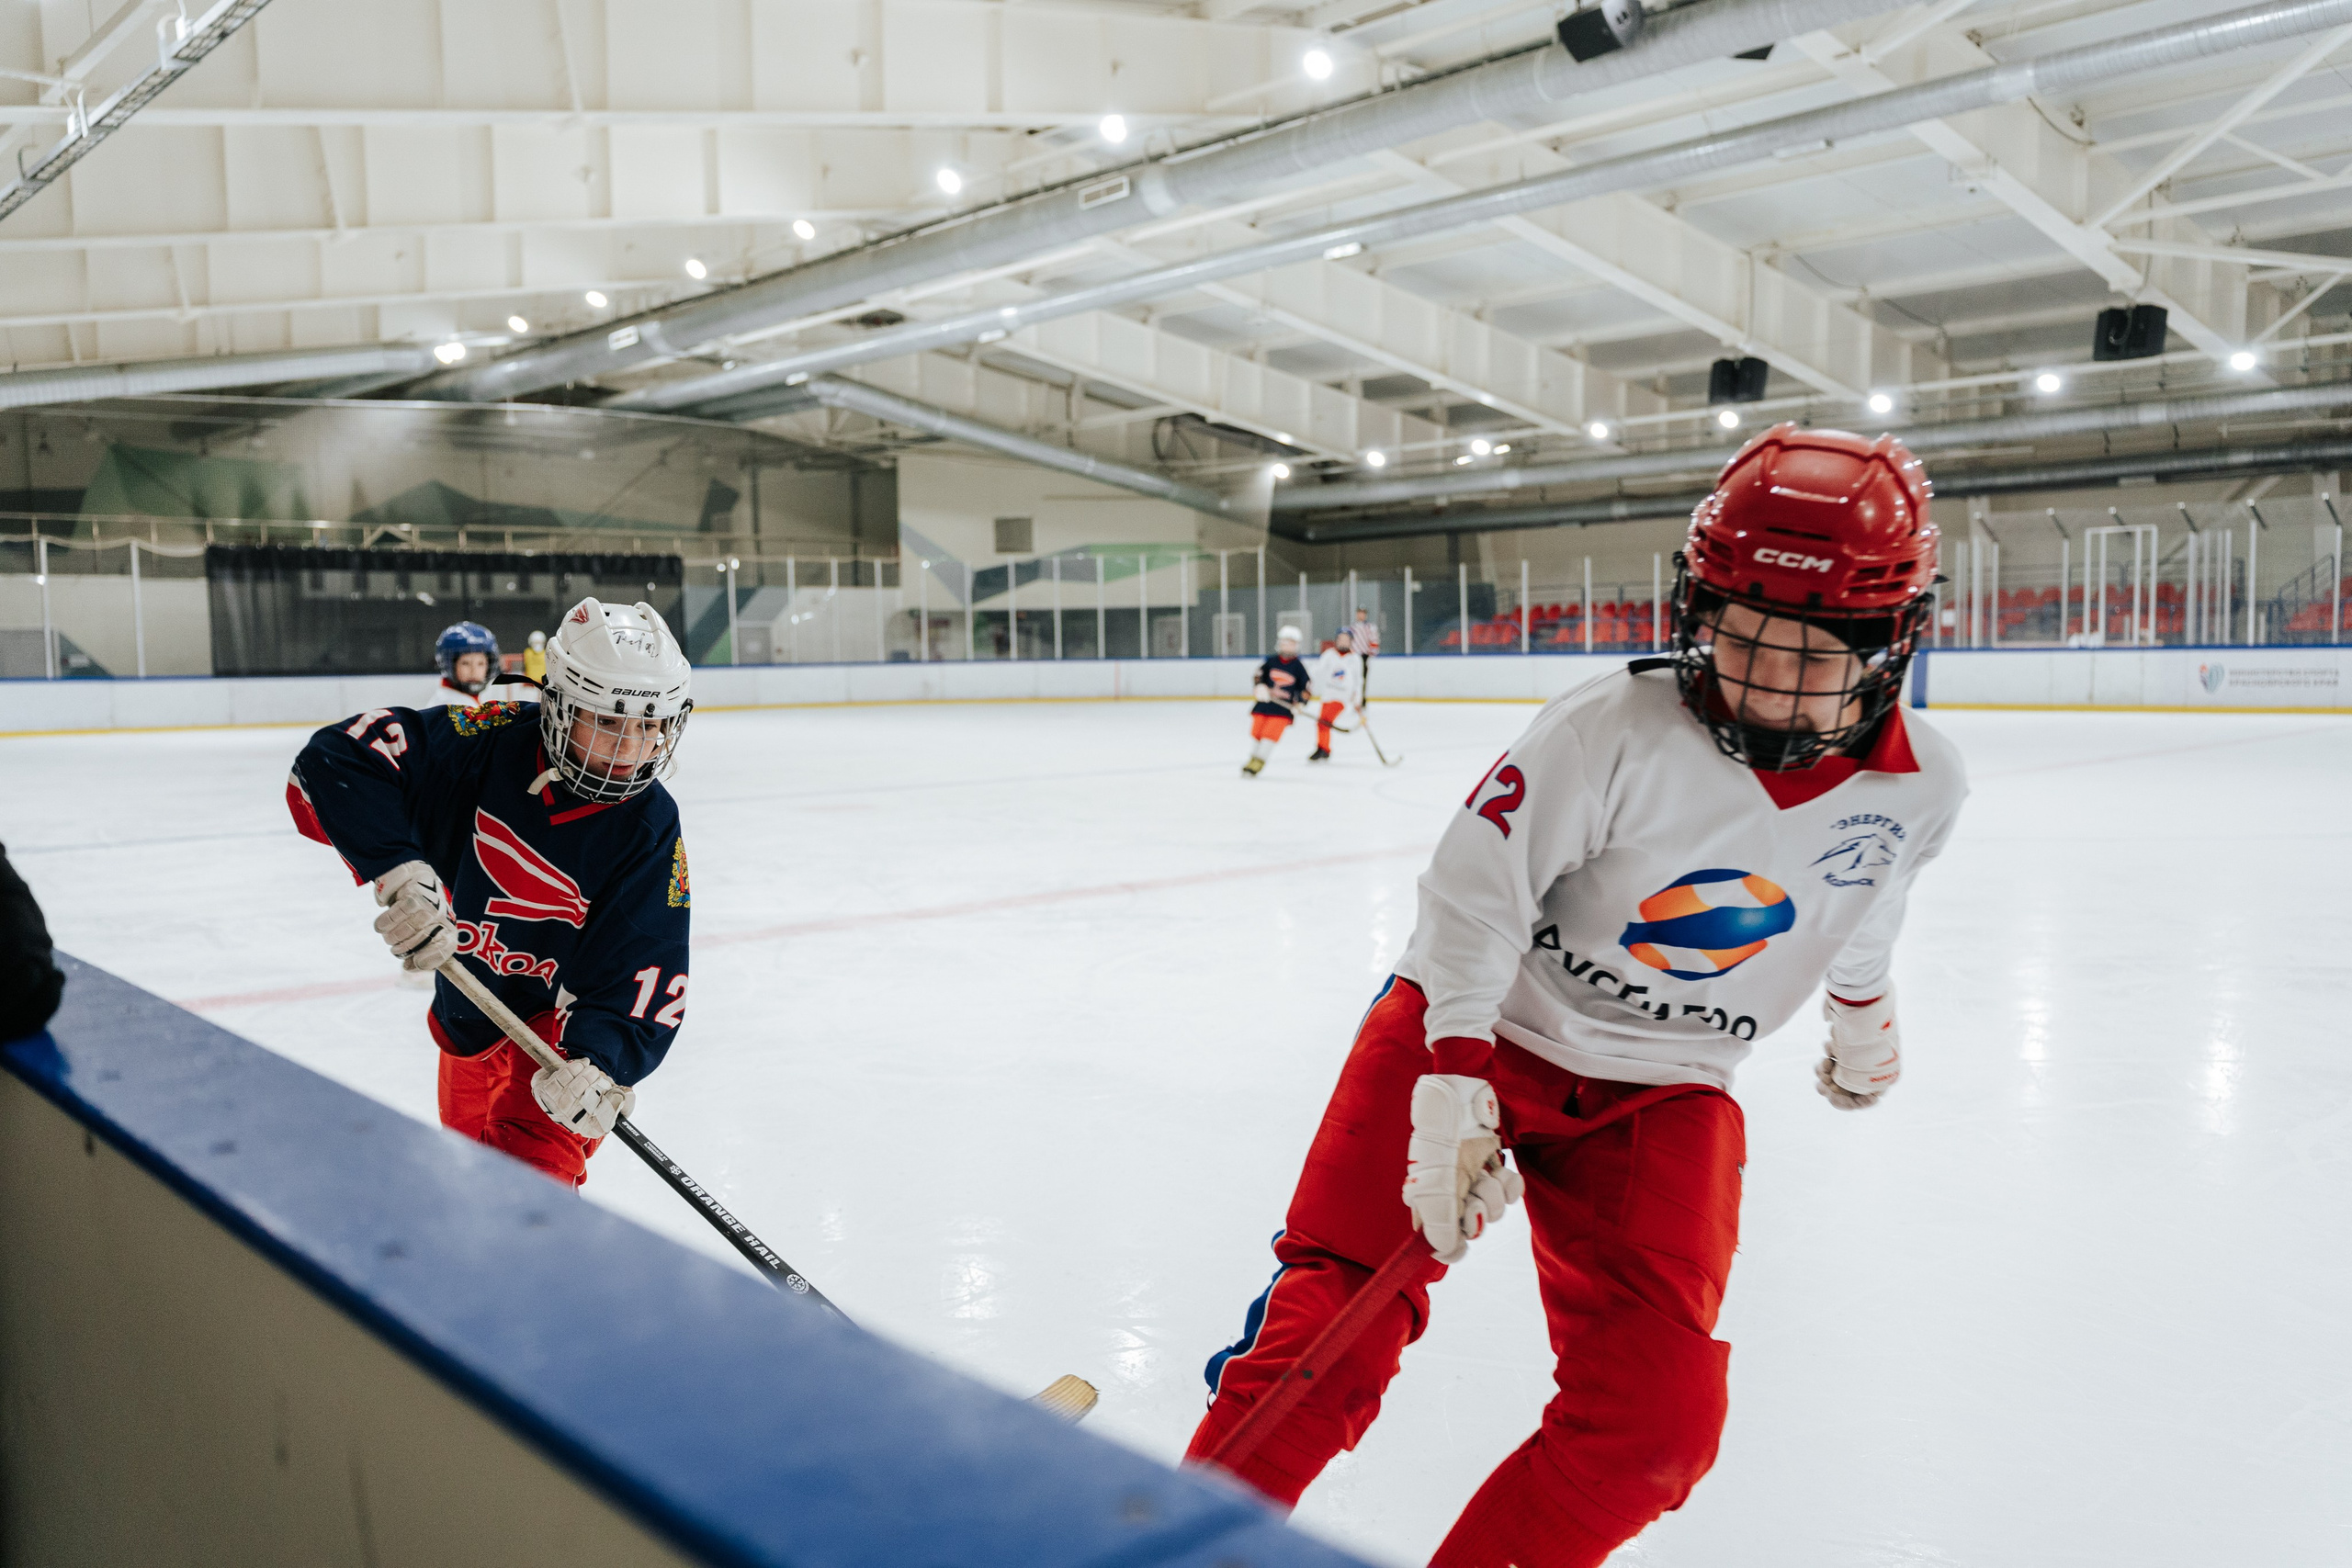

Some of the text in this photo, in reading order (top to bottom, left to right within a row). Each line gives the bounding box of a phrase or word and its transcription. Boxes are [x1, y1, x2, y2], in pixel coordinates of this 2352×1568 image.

[1753, 547, 1835, 573] CCM
[611, 687, 661, 698] BAUER
[345, 707, 408, 771] 12
[629, 965, 689, 1030] 12
[680, 1176, 781, 1269] ORANGE HAIL
